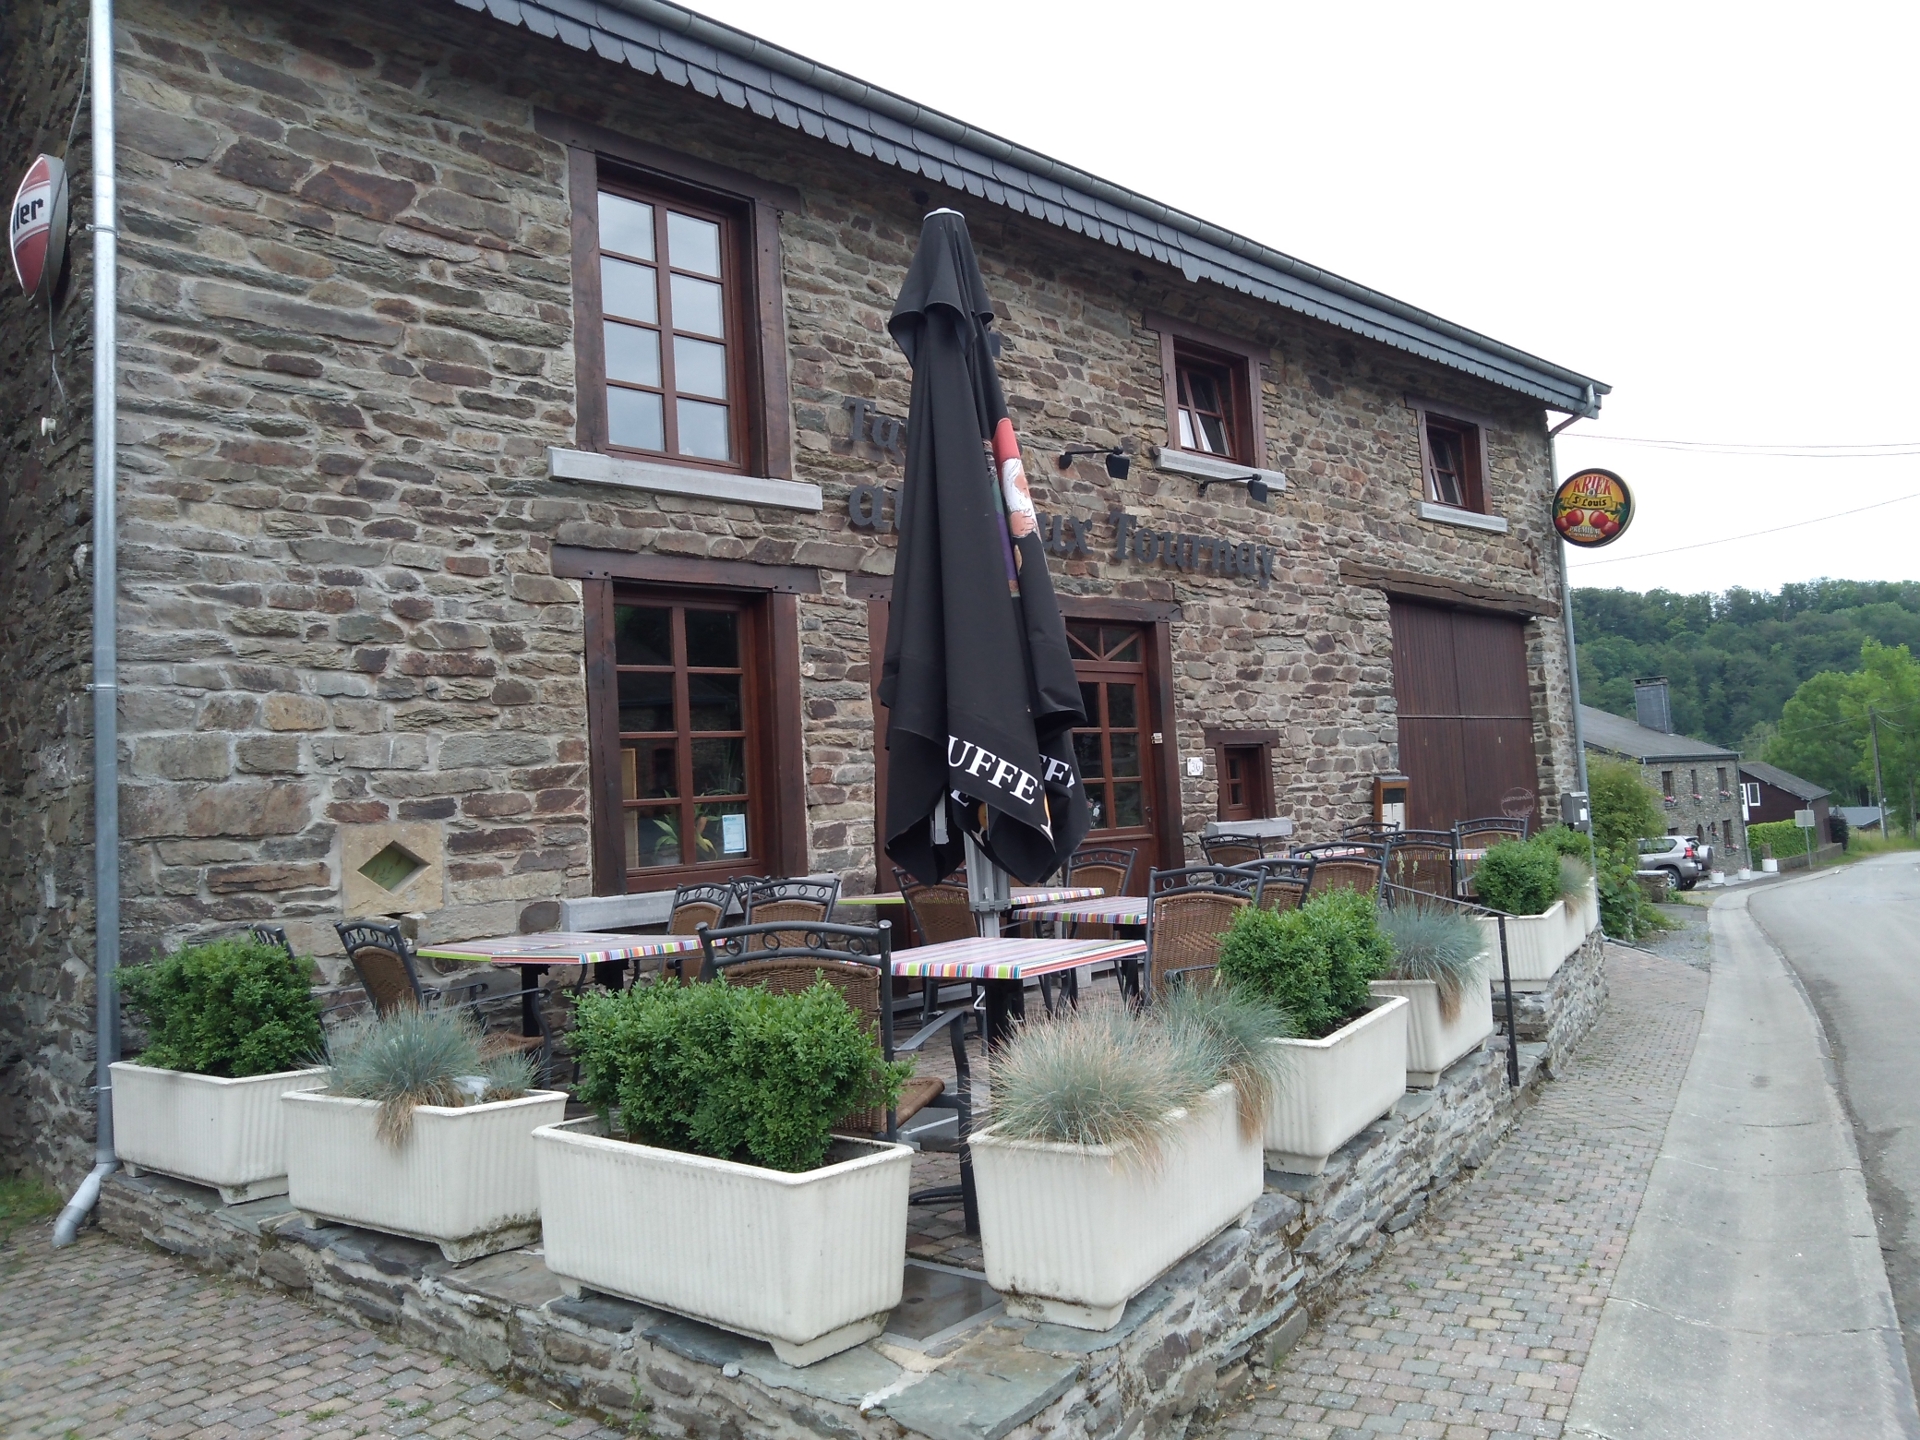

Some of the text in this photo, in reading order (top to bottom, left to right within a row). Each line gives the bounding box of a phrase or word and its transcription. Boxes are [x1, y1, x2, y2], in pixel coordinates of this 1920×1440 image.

[1573, 476, 1612, 496] KRIEK
[1581, 498, 1607, 507] Louis
[1108, 510, 1278, 590] Tournay
